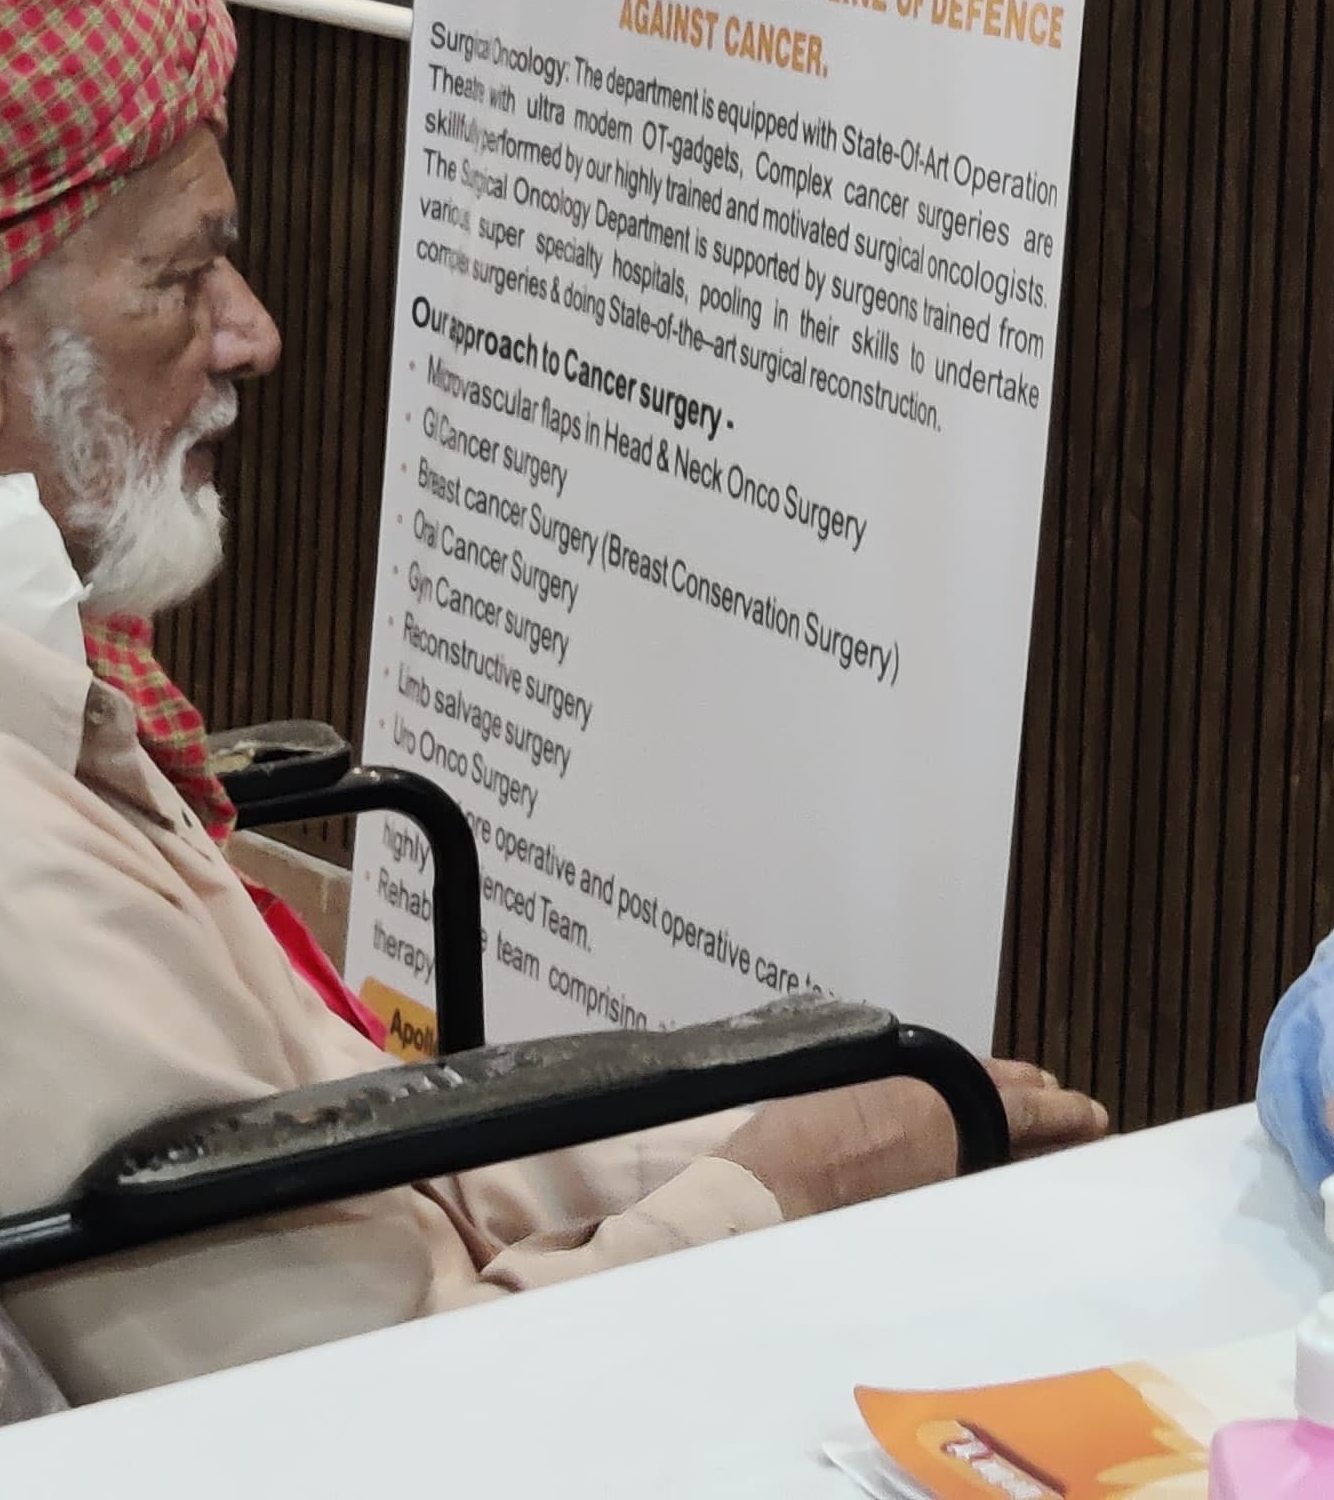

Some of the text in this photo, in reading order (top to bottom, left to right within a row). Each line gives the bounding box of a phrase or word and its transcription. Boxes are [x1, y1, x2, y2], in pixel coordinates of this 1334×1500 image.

[724, 18, 829, 79] CANCER.
[490, 84, 516, 114] with
[527, 92, 566, 126] ultra
[642, 120, 743, 180] OT-gadgets,
[755, 151, 834, 200] Complex
[844, 180, 910, 220] cancer
[917, 200, 1010, 247] surgeries
[1024, 227, 1054, 259] are
[575, 56, 603, 90] The
[606, 66, 699, 116] department
[702, 88, 715, 120] is
[717, 99, 799, 141] equipped
[802, 116, 838, 152] with
[842, 124, 950, 182] State-Of-Art
[954, 155, 1059, 208] Operation
[422, 147, 457, 182] The
[514, 176, 592, 230] Oncology
[595, 198, 691, 255] Department
[695, 227, 708, 259] is
[713, 239, 801, 287] supported
[805, 258, 827, 302] by
[831, 273, 918, 323] surgeons
[923, 296, 991, 344] trained
[999, 316, 1045, 360] from
[566, 144, 583, 182] by
[586, 157, 613, 183] our
[615, 158, 663, 206] highly
[666, 173, 723, 216] trained
[726, 197, 759, 228] and
[763, 207, 851, 253] motivated
[854, 232, 925, 275] surgical
[928, 259, 1047, 309] oncologists.
[411, 296, 450, 336] Our
[449, 315, 539, 369] approach
[542, 340, 560, 376] to
[564, 348, 637, 402] Cancer
[640, 380, 722, 441] surgery
[472, 258, 548, 301] surgeries
[550, 275, 561, 305] &
[563, 281, 606, 327] doing
[740, 342, 807, 384] surgical
[809, 366, 942, 432] reconstruction.
[478, 216, 526, 248] super
[535, 231, 603, 279] specialty
[613, 248, 688, 305] hospitals,
[699, 283, 762, 330] pooling
[773, 298, 789, 333] in
[800, 307, 840, 347] their
[851, 326, 899, 366] skills
[910, 341, 925, 375] to
[935, 356, 1040, 409] undertake
[439, 413, 500, 464] Cancer
[503, 444, 568, 498] surgery
[541, 396, 581, 442] flaps
[585, 411, 600, 448] in
[604, 416, 653, 467] Head
[656, 437, 670, 474] &
[674, 443, 723, 493] Neck
[727, 464, 781, 513] Onco
[784, 483, 867, 552] Surgery
[413, 507, 579, 614] Oral Cancer Surgery
[418, 455, 900, 688] Breast cancer Surgery (Breast Conservation Surgery)
[435, 576, 503, 627] Cancer
[504, 608, 570, 666] surgery
[397, 661, 572, 779] Limb salvage surgery
[403, 610, 594, 732] Reconstructive surgery
[393, 710, 539, 819] Uro Onco Surgery
[372, 917, 436, 985] therapy
[382, 814, 431, 875] highly
[539, 895, 592, 953] Team.
[495, 825, 577, 887] operative
[580, 867, 616, 906] and
[618, 885, 659, 929] post
[661, 908, 751, 975] operative
[496, 930, 540, 982] team
[390, 1007, 434, 1057] Apoll
